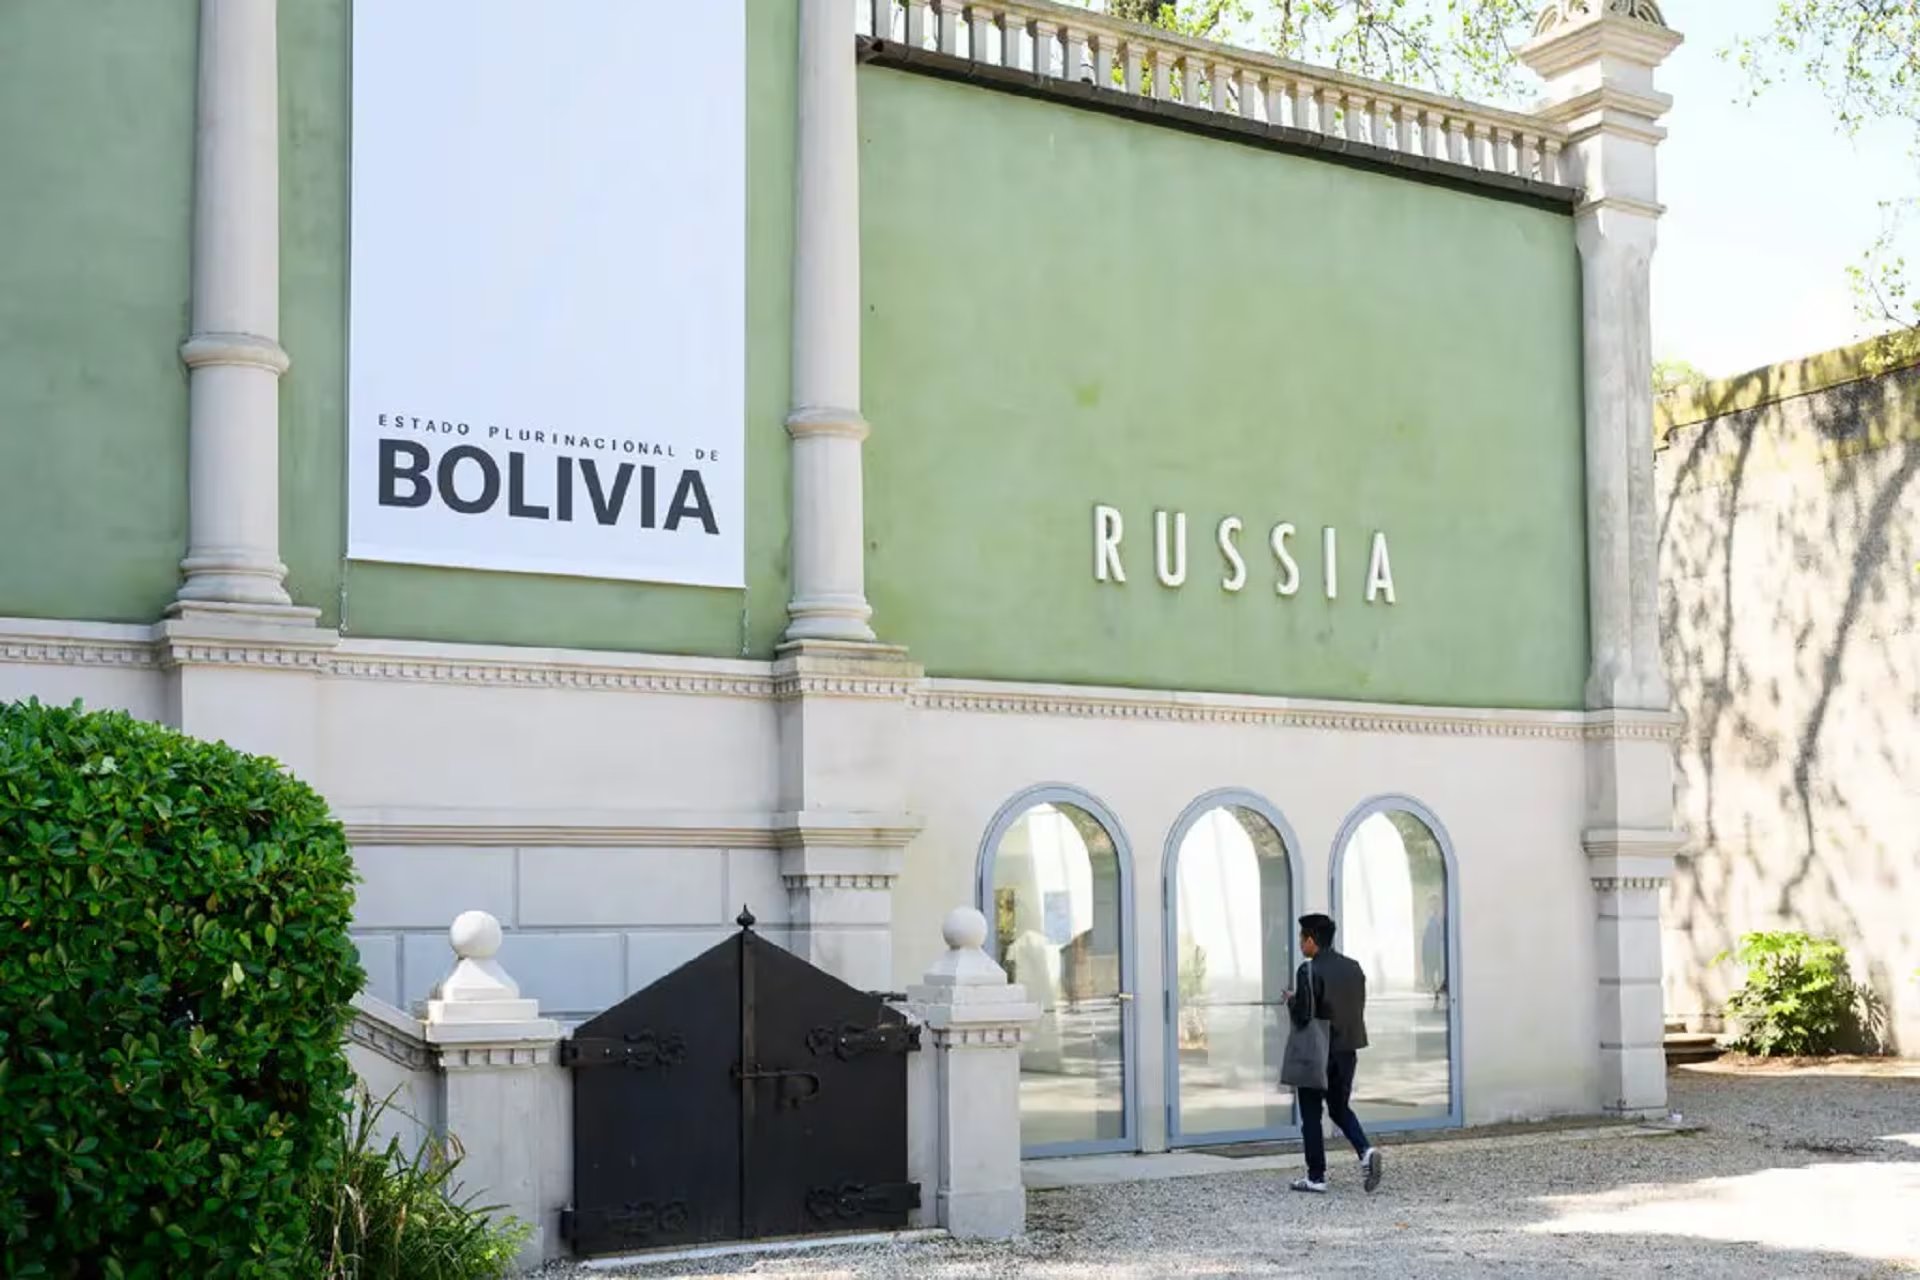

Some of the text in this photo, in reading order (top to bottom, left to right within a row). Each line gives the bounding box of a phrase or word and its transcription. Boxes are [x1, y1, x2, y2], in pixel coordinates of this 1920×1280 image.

[378, 414, 720, 462] ESTADO PLURINACIONAL DE
[378, 438, 721, 535] BOLIVIA
[1094, 504, 1397, 604] RUSSIA
